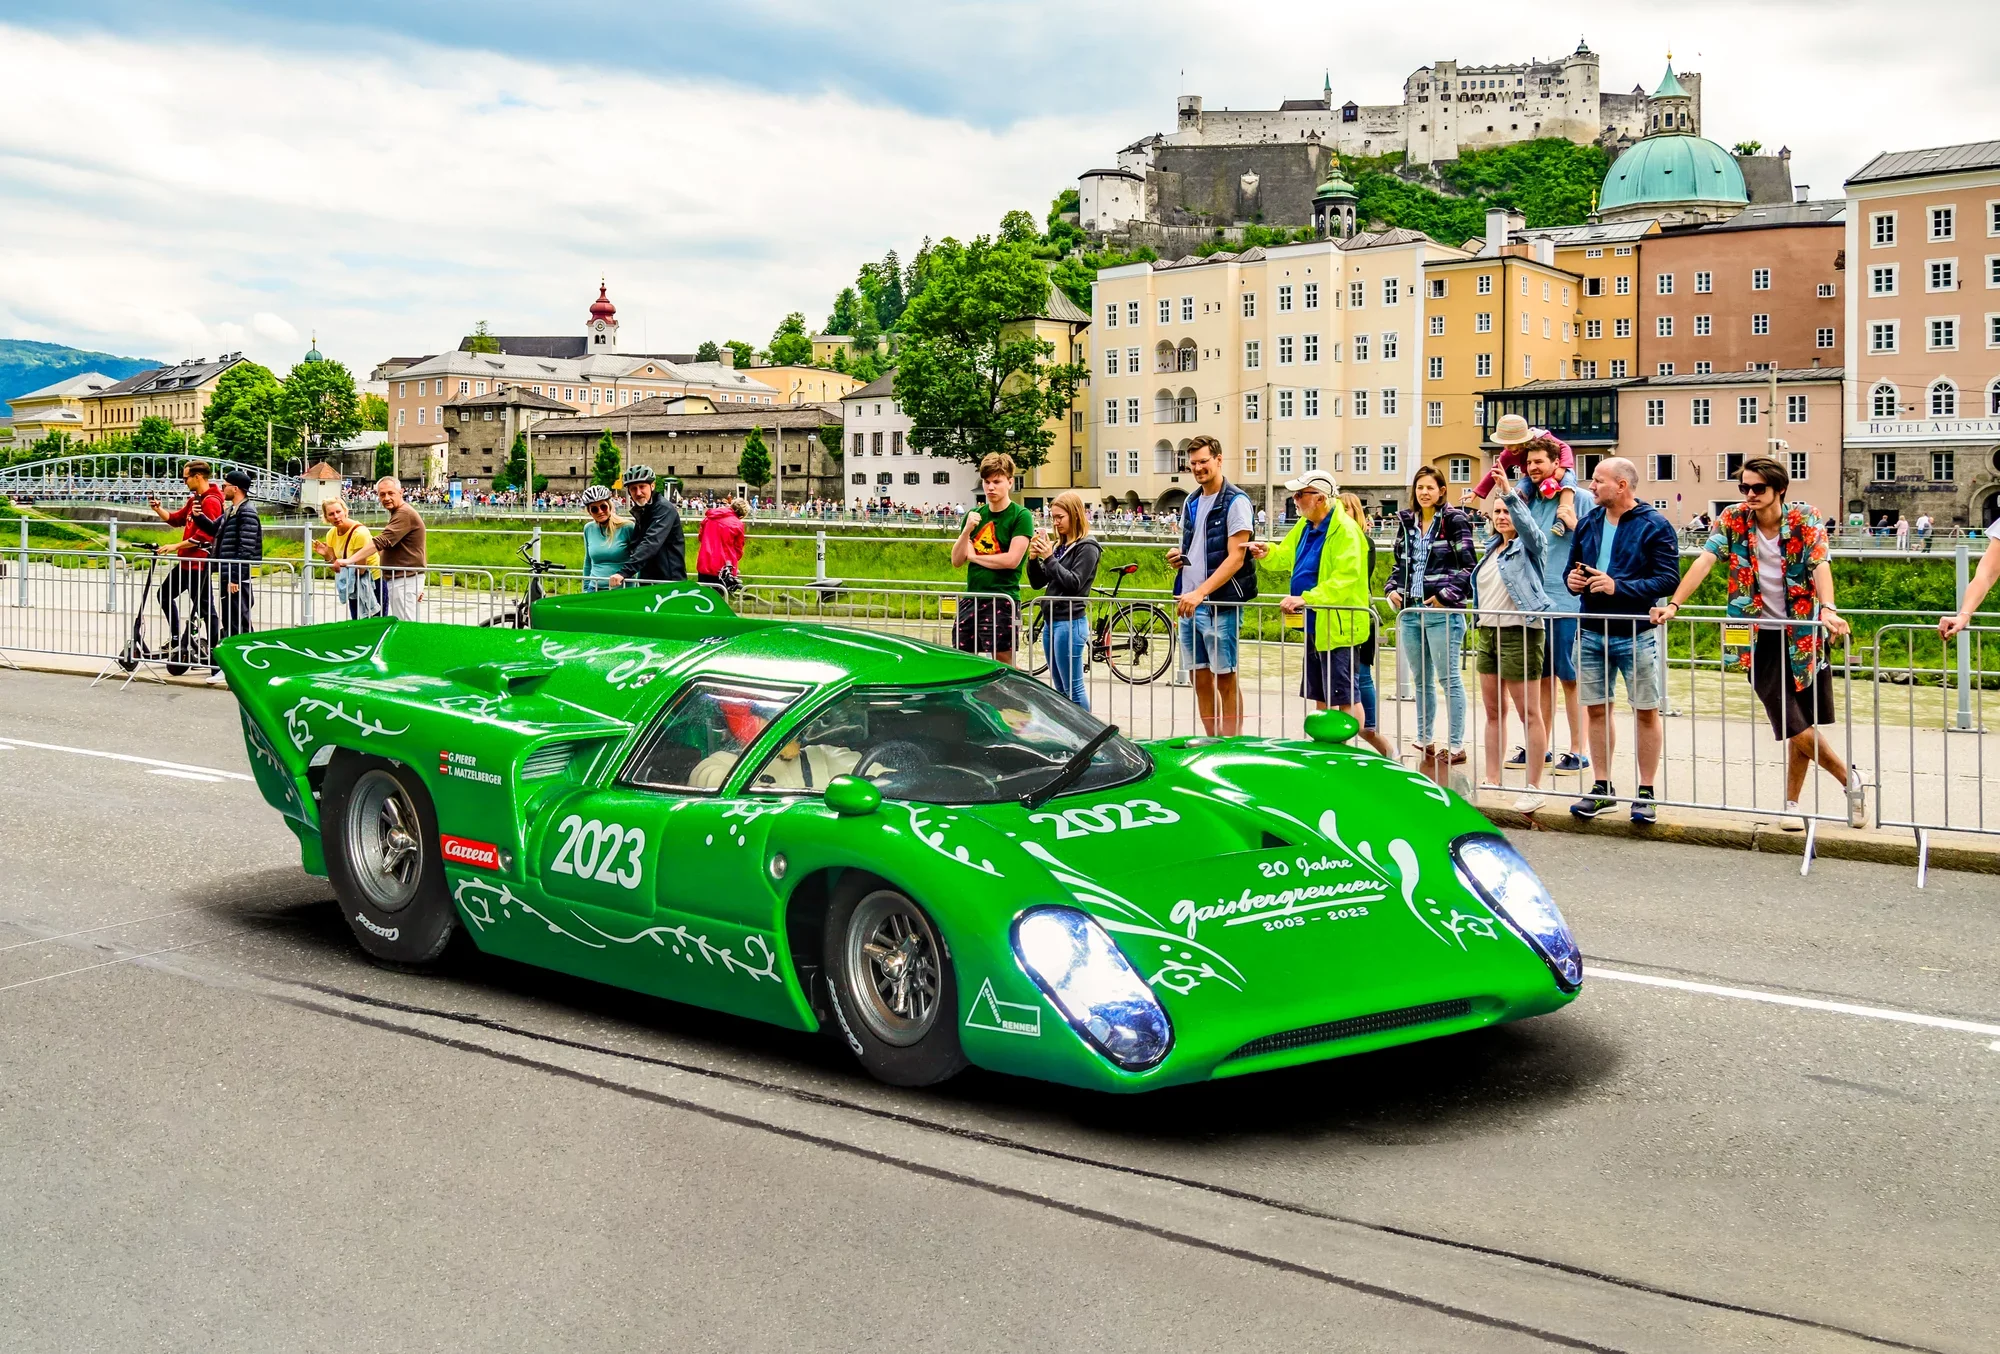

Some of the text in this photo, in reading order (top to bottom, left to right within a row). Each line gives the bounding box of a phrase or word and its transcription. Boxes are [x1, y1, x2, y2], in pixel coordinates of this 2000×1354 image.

[1870, 422, 2000, 434] HOTEL ALTSTA
[448, 752, 476, 766] G.PIERER
[448, 765, 502, 785] T. MATZELBERGER
[1028, 799, 1180, 840] 2023
[445, 840, 494, 863] Carrera
[550, 814, 646, 889] 2023
[1258, 856, 1353, 877] 20 Jahre
[356, 912, 400, 941] Carrera
[1262, 916, 1305, 931] 2003
[1327, 906, 1369, 921] 2023
[827, 976, 864, 1055] Carrera
[984, 987, 1002, 1024] GAISBERG
[1002, 1020, 1038, 1033] RENNEN
